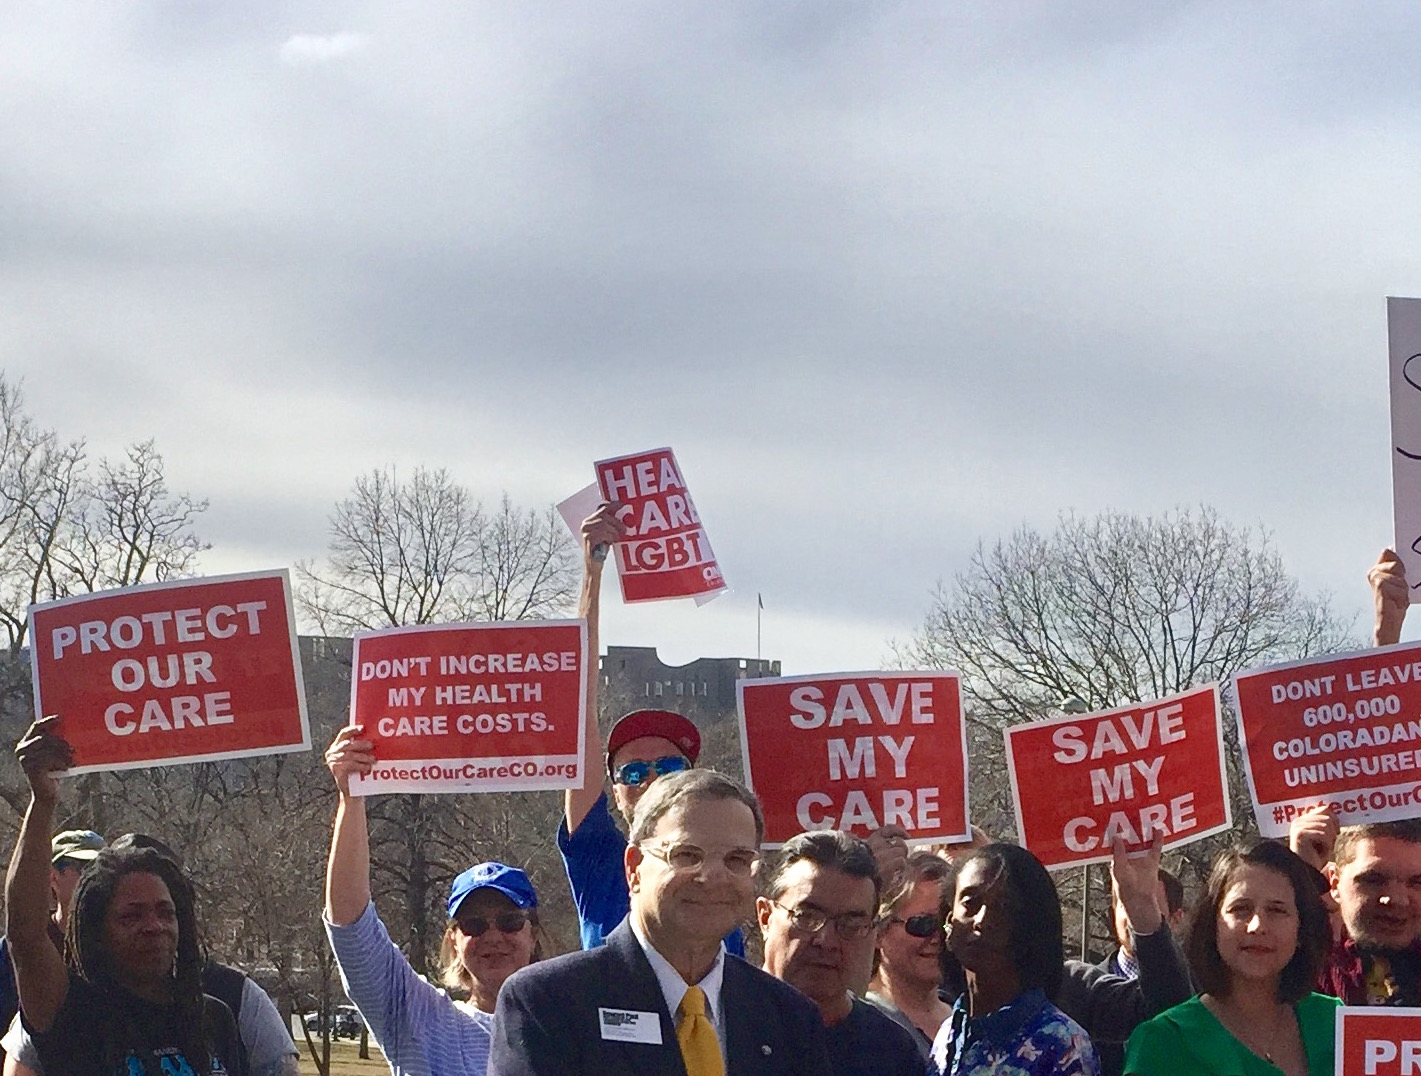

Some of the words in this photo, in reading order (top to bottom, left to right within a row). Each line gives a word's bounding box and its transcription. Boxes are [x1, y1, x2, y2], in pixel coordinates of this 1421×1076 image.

[604, 458, 685, 501] HEA
[620, 532, 703, 573] LGBT
[51, 601, 267, 660] PROTECT
[111, 651, 216, 692] OUR
[361, 656, 431, 681] DON'T
[440, 652, 577, 675] INCREASE
[388, 686, 427, 707] MY
[435, 682, 542, 705] HEALTH
[789, 682, 934, 730] SAVE
[1271, 675, 1336, 704] DONT
[104, 691, 234, 736] CARE
[378, 715, 448, 737] CARE
[456, 712, 555, 735] COSTS.
[1303, 695, 1401, 728] 600,000
[1052, 703, 1186, 764] SAVE
[827, 735, 915, 780] MY
[1089, 755, 1166, 806] MY
[796, 788, 941, 832] CARE
[1063, 792, 1198, 853] CARE
